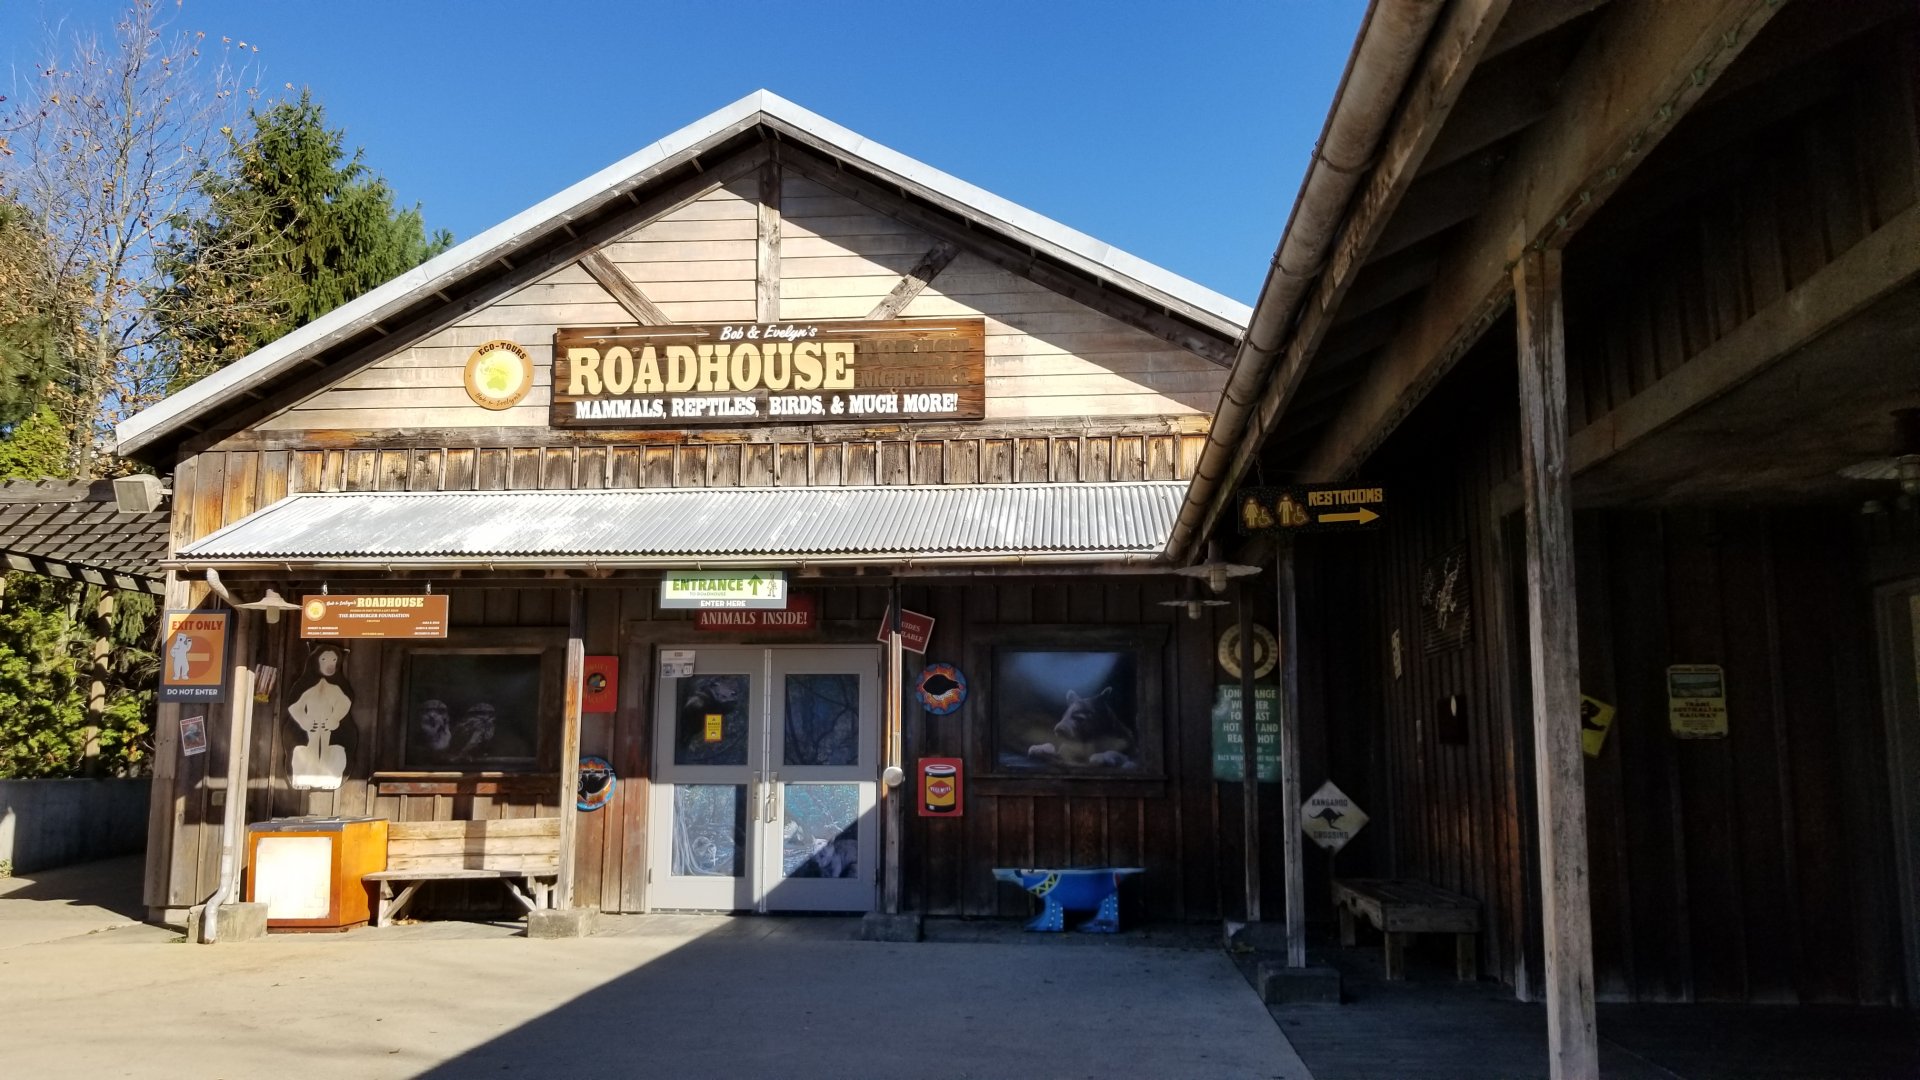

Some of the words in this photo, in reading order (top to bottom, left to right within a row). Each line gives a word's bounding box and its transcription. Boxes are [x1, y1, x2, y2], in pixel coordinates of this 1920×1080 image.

[720, 326, 744, 340] Bob
[747, 325, 760, 339] &
[763, 325, 818, 341] Evelyn's
[478, 343, 526, 359] ECO-TOURS
[568, 342, 855, 395] ROADHOUSE
[576, 399, 667, 419] MAMMALS,
[672, 397, 759, 417] REPTILES,
[769, 396, 825, 415] BIRDS,
[830, 395, 844, 414] &
[849, 394, 898, 413] MUCH
[903, 393, 958, 412] MORE!
[1308, 488, 1383, 506] RESTROOMS
[672, 579, 744, 591] ENTRANCE
[356, 597, 424, 608] ROADHOUSE
[701, 611, 757, 625] ANIMALS
[762, 611, 808, 625] INSIDE!
[172, 621, 194, 631] EXIT
[196, 621, 223, 631] ONLY
[901, 621, 921, 632] UIDES
[195, 688, 218, 696] ENTER
[1223, 689, 1242, 698] LON
[1254, 689, 1277, 699] ANGE
[1223, 723, 1240, 732] HOT
[1260, 723, 1279, 732] AND
[1257, 735, 1275, 743] HOT
[1312, 799, 1348, 807] KANGAROO
